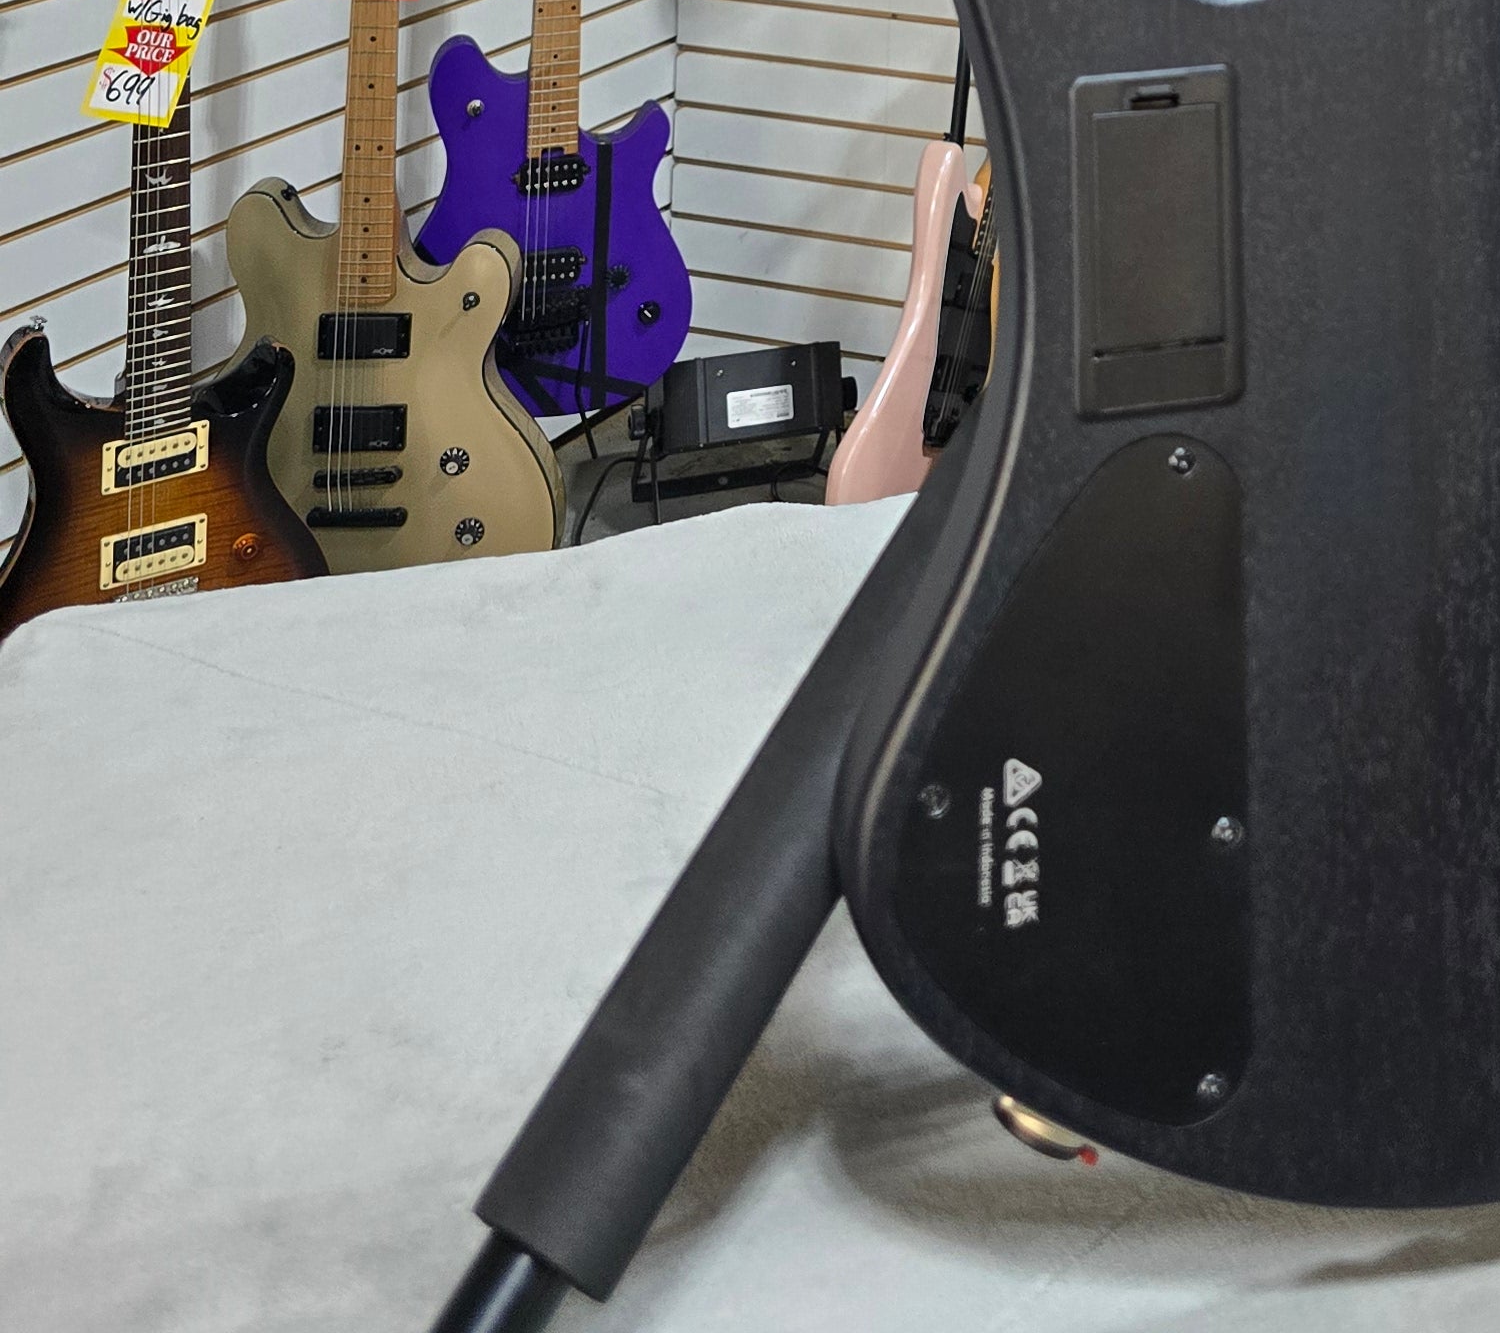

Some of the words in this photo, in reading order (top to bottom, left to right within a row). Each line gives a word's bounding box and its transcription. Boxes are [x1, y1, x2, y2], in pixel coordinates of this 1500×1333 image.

[136, 29, 174, 48] OUR
[176, 3, 203, 41] bag
[124, 43, 176, 64] PRICE
[979, 786, 995, 825] Made
[979, 842, 995, 907] Indonesia
